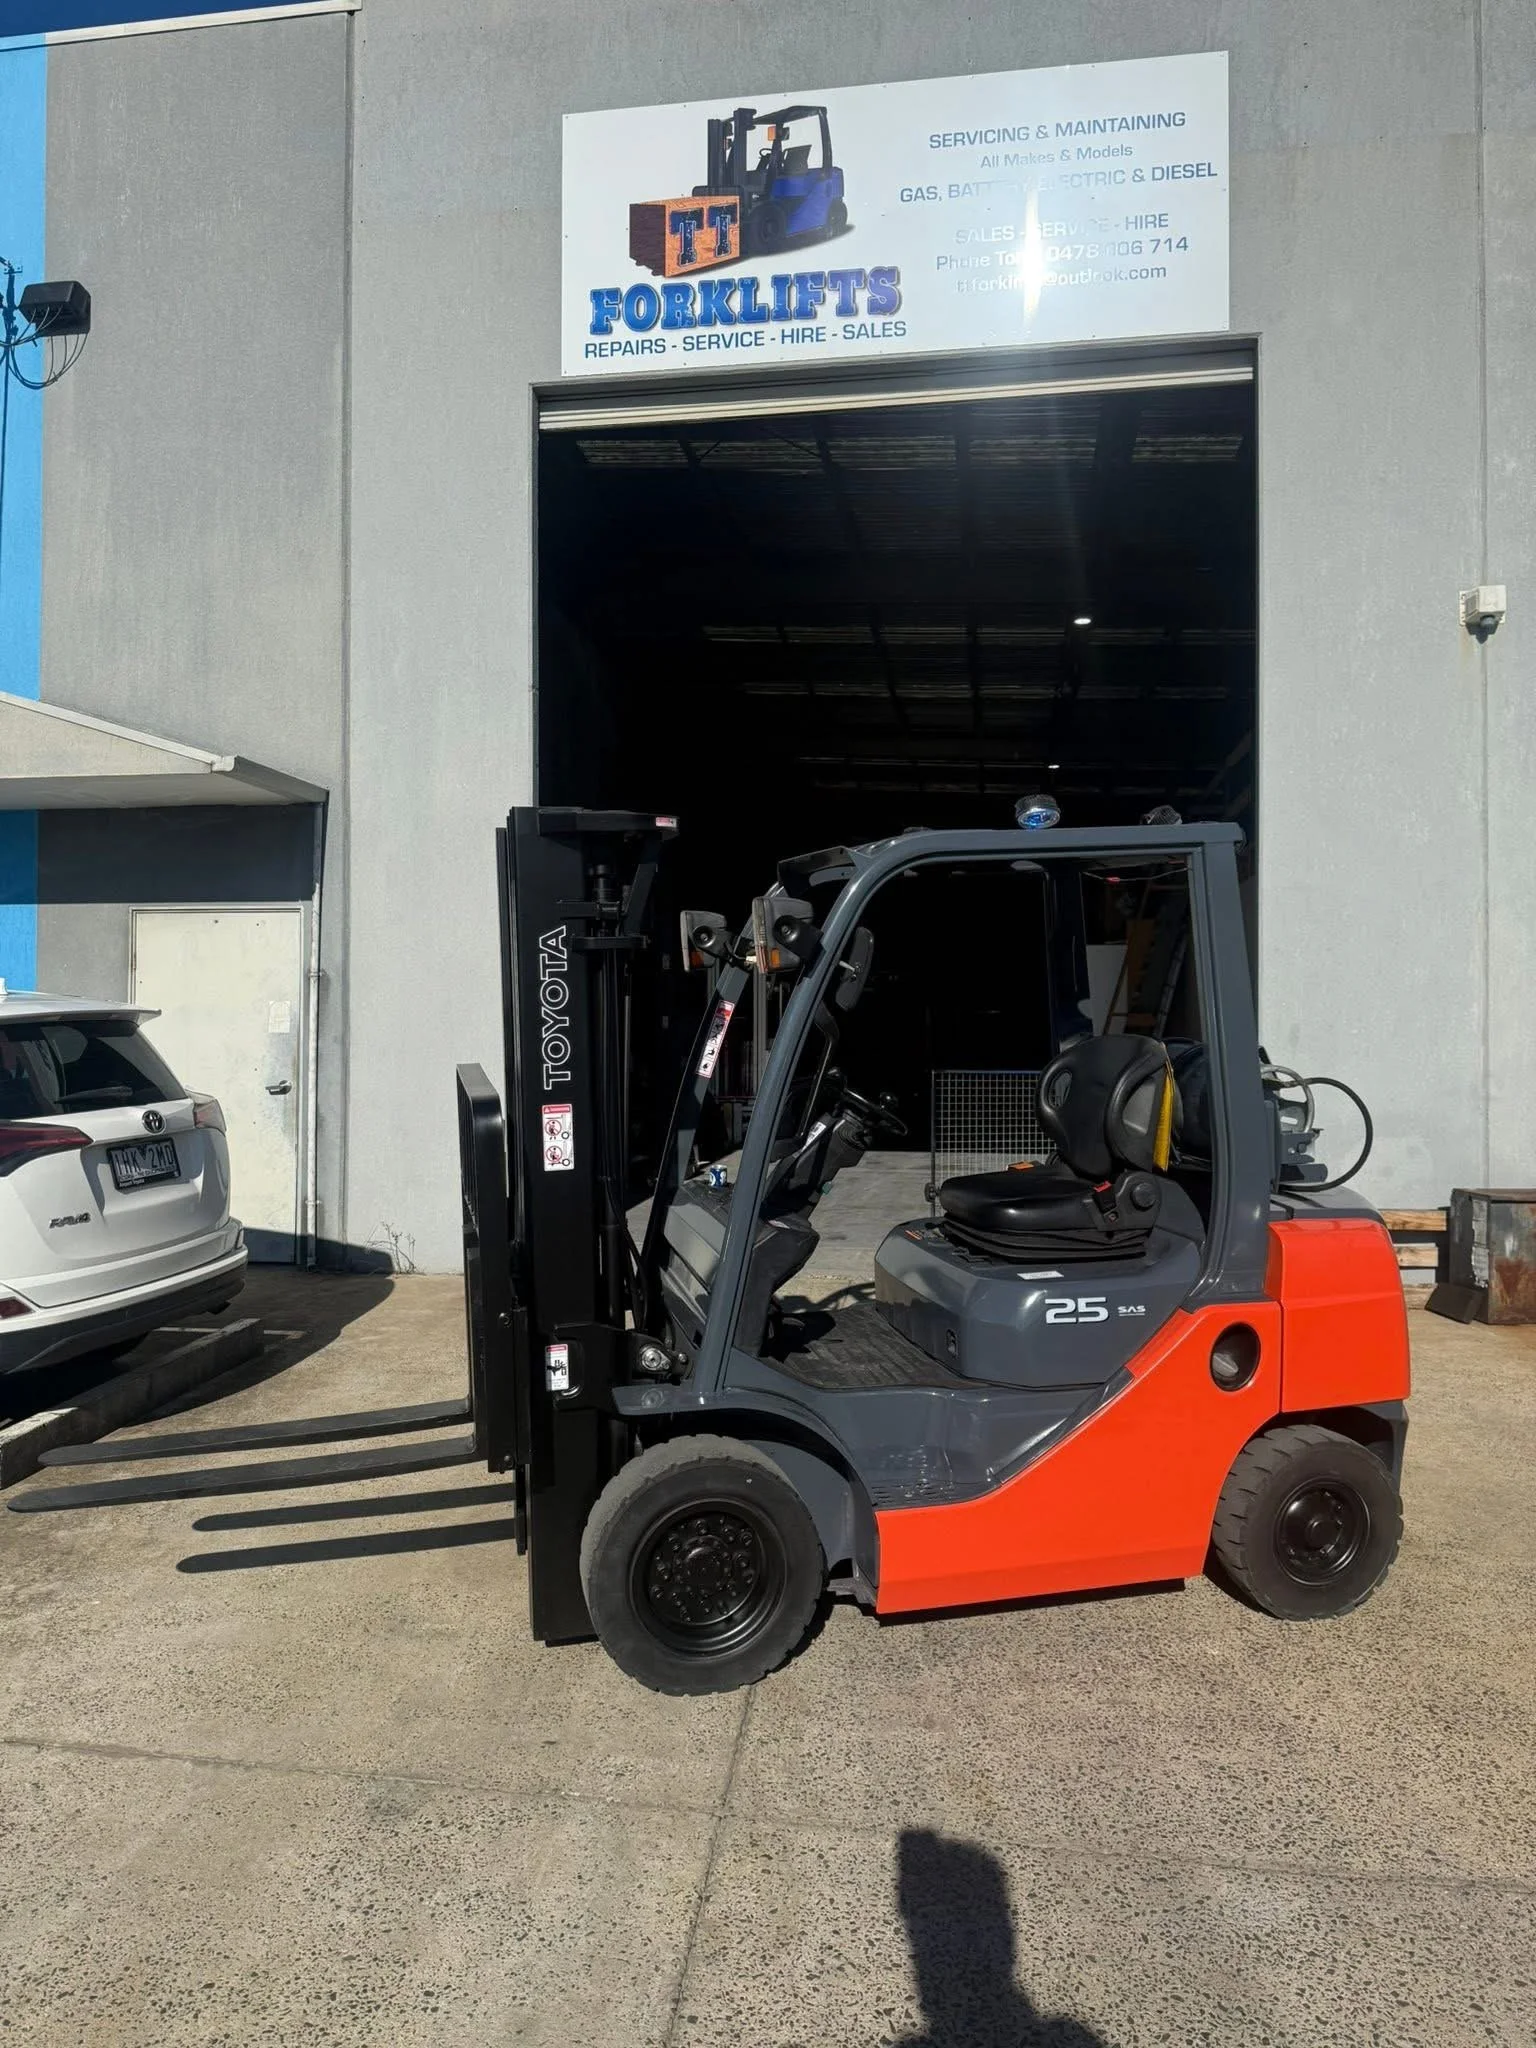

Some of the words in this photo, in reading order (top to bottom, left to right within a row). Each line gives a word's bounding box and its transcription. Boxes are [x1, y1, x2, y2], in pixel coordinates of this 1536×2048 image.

[929, 126, 1031, 150] SERVICING
[1035, 124, 1049, 139] &
[1055, 111, 1187, 138] MAINTAINING
[980, 154, 999, 169] All
[1004, 150, 1055, 167] Makes
[1076, 143, 1133, 161] Models
[899, 185, 943, 204] GAS,
[1131, 167, 1145, 183] &
[1151, 161, 1218, 182] DIESEL
[1125, 212, 1169, 231] HIRE
[1149, 236, 1189, 254] 714
[588, 265, 903, 336] FORKLIFTS
[584, 338, 667, 359] REPAIRS
[682, 330, 765, 352] SERVICE
[780, 326, 827, 345] HIRE
[842, 321, 907, 339] SALES
[539, 925, 571, 1090] TOYOTA
[1045, 1296, 1109, 1324] 25
[1117, 1305, 1146, 1314] SAS
